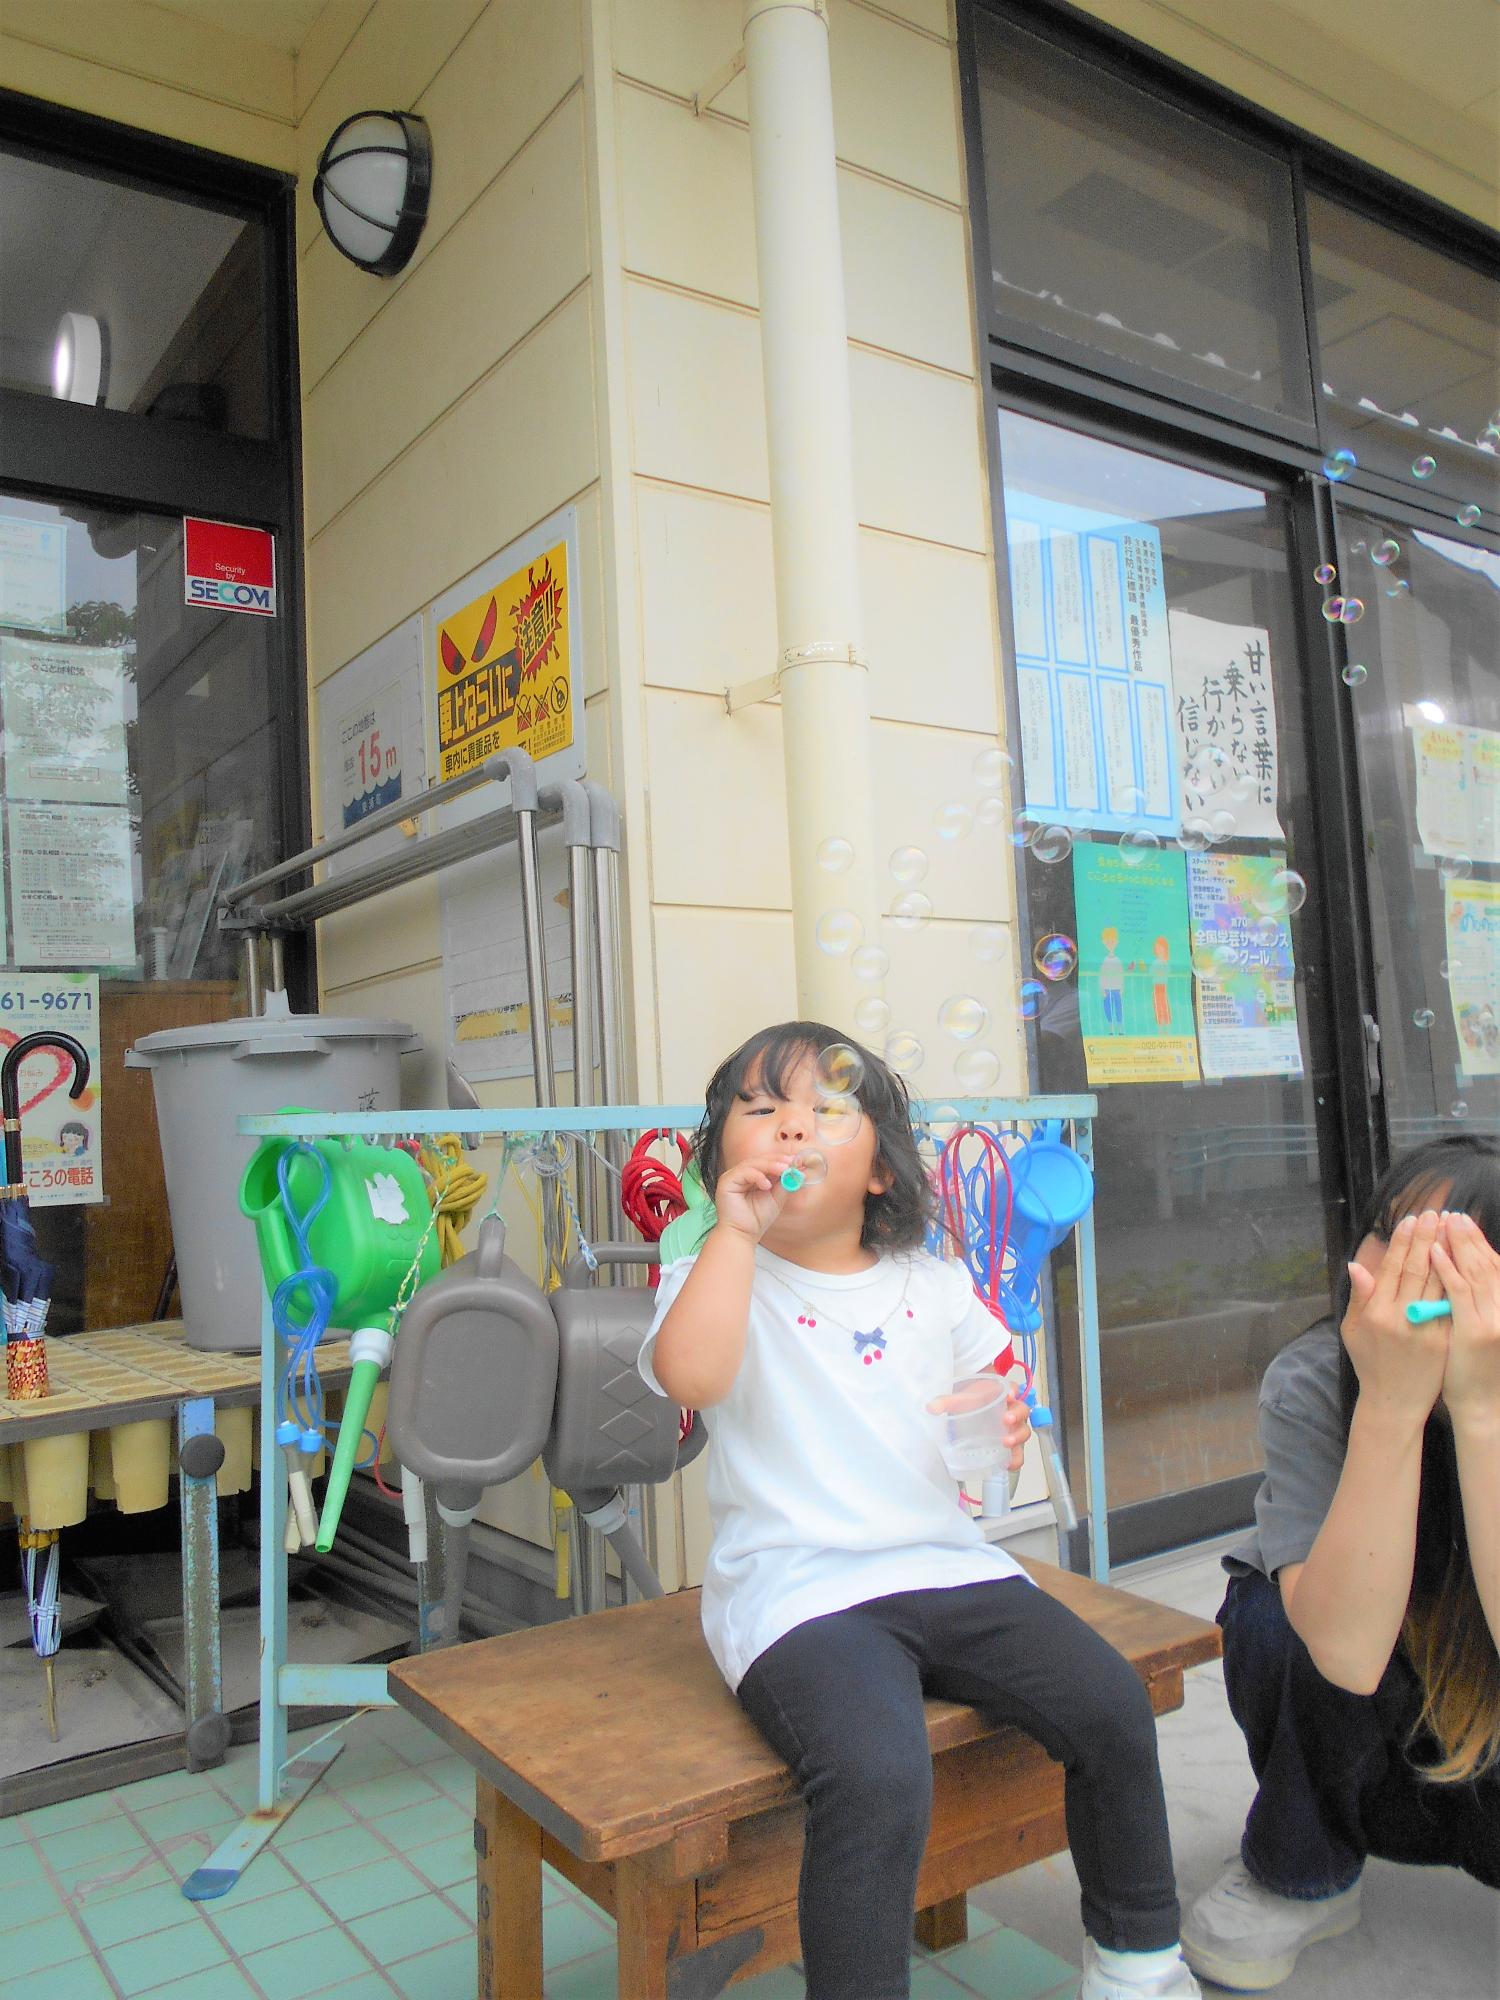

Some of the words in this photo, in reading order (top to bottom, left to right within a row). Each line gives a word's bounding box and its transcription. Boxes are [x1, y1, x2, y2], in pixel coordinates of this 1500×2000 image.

[191, 579, 270, 608] SECOM
[215, 562, 246, 575] Security
[225, 572, 235, 581] by
[1130, 614, 1143, 672] 最優秀作品
[440, 664, 514, 745] 車上ねらいに
[1202, 675, 1225, 790] 行かない
[1223, 660, 1250, 780] 乗らない
[1243, 639, 1274, 804] 甘い言葉に
[445, 730, 501, 773] 車内に貴重品を
[1176, 695, 1205, 811] 信じない
[23, 1166, 94, 1187] ころの電話
